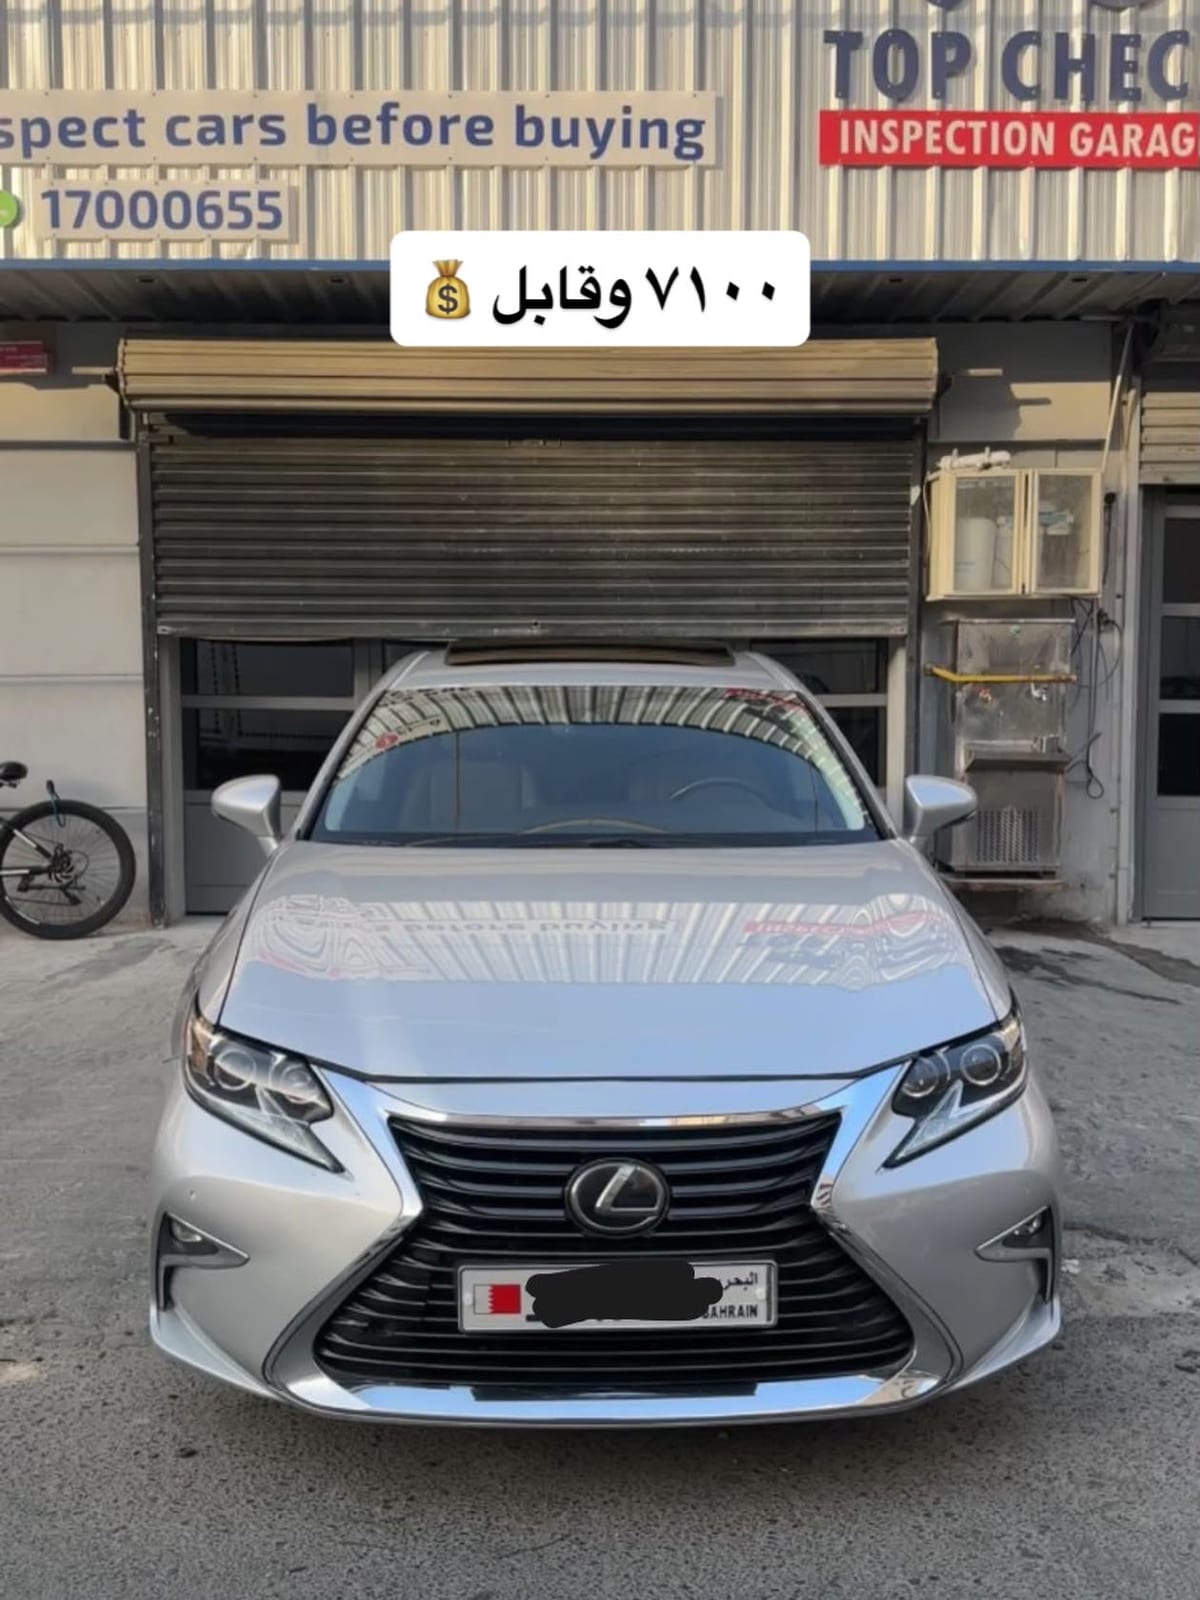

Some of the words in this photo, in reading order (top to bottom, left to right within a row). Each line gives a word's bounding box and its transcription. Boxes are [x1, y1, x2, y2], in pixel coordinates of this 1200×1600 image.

[823, 30, 972, 101] TOP
[1001, 30, 1190, 102] CHEC
[0, 108, 146, 159] spect
[165, 114, 287, 147] cars
[306, 102, 495, 147] before
[514, 104, 705, 161] buying
[840, 119, 1055, 155] INSPECTION
[1069, 121, 1196, 158] GARAG
[41, 189, 283, 231] 17000655
[722, 1271, 758, 1291] البحر
